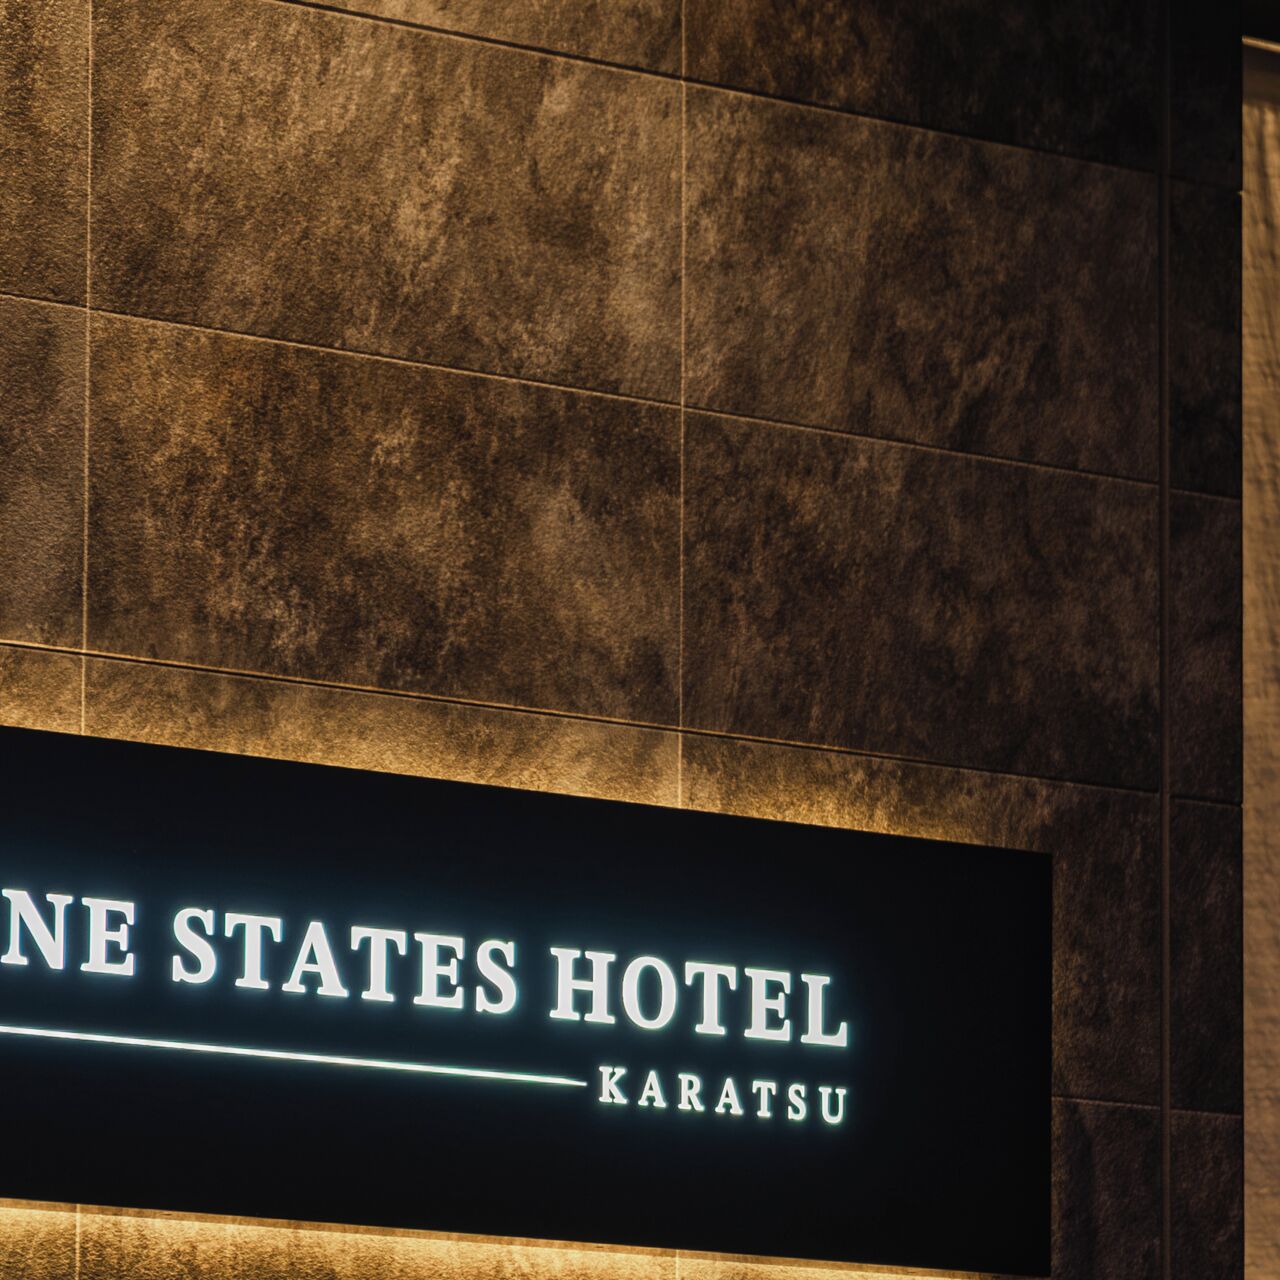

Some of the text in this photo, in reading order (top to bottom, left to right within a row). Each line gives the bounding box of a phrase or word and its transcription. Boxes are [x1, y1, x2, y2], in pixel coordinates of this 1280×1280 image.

[170, 905, 521, 1016] STATES
[547, 945, 849, 1049] HOTEL
[597, 1064, 848, 1126] KARATSU
